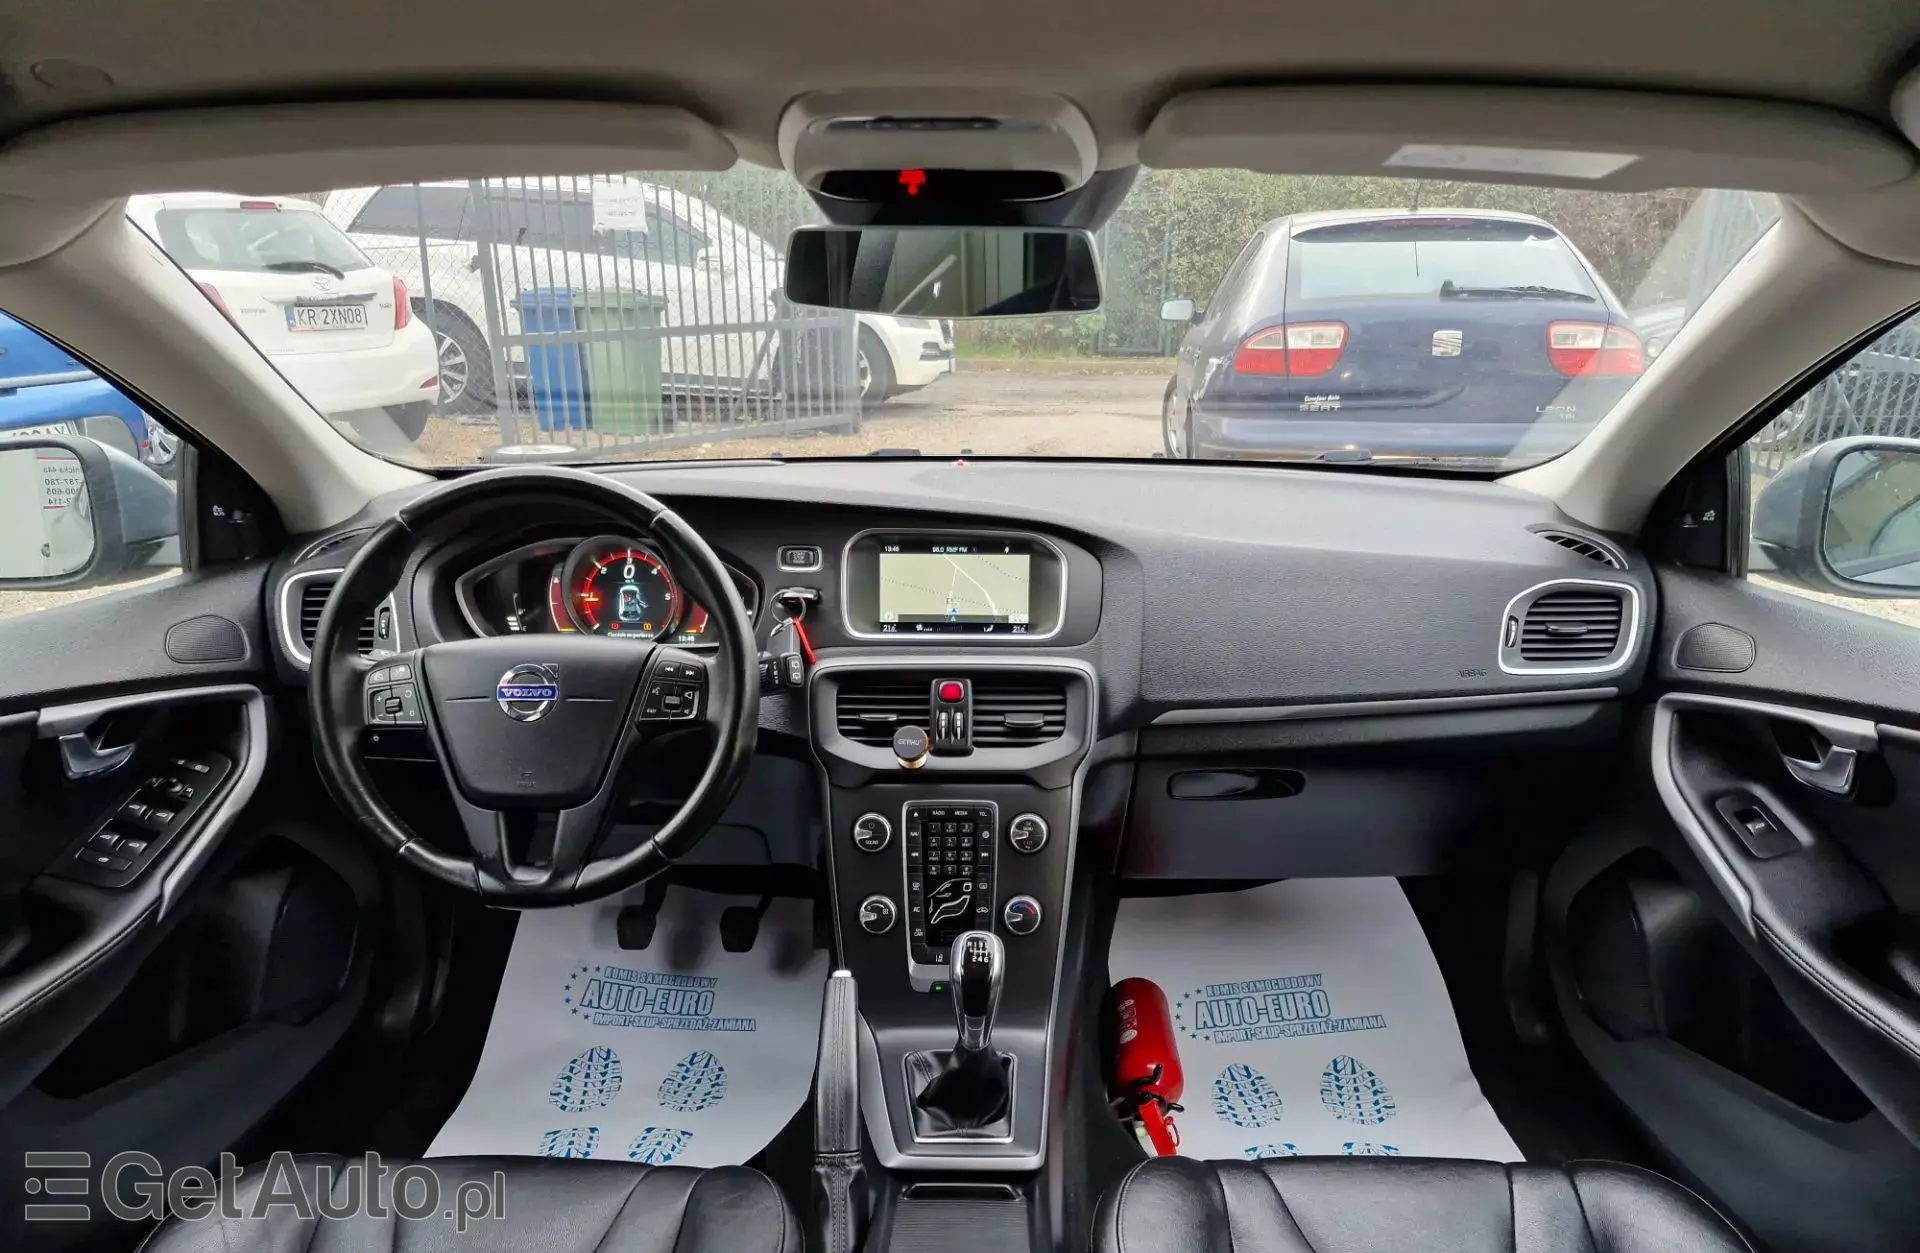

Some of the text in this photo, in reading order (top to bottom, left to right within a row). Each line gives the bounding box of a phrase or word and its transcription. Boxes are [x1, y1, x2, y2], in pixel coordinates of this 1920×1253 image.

[297, 307, 363, 326] KR 2XN08
[1300, 404, 1341, 412] SEAT
[623, 564, 635, 579] 0
[501, 687, 553, 698] VOLVO
[604, 966, 718, 988] KOMIS SAMOCHODOWY
[1205, 973, 1323, 998] KOMIS SAMOCHODOWY
[580, 978, 716, 1017] AUTO-EURO
[1195, 989, 1331, 1030] AUTO-EURO
